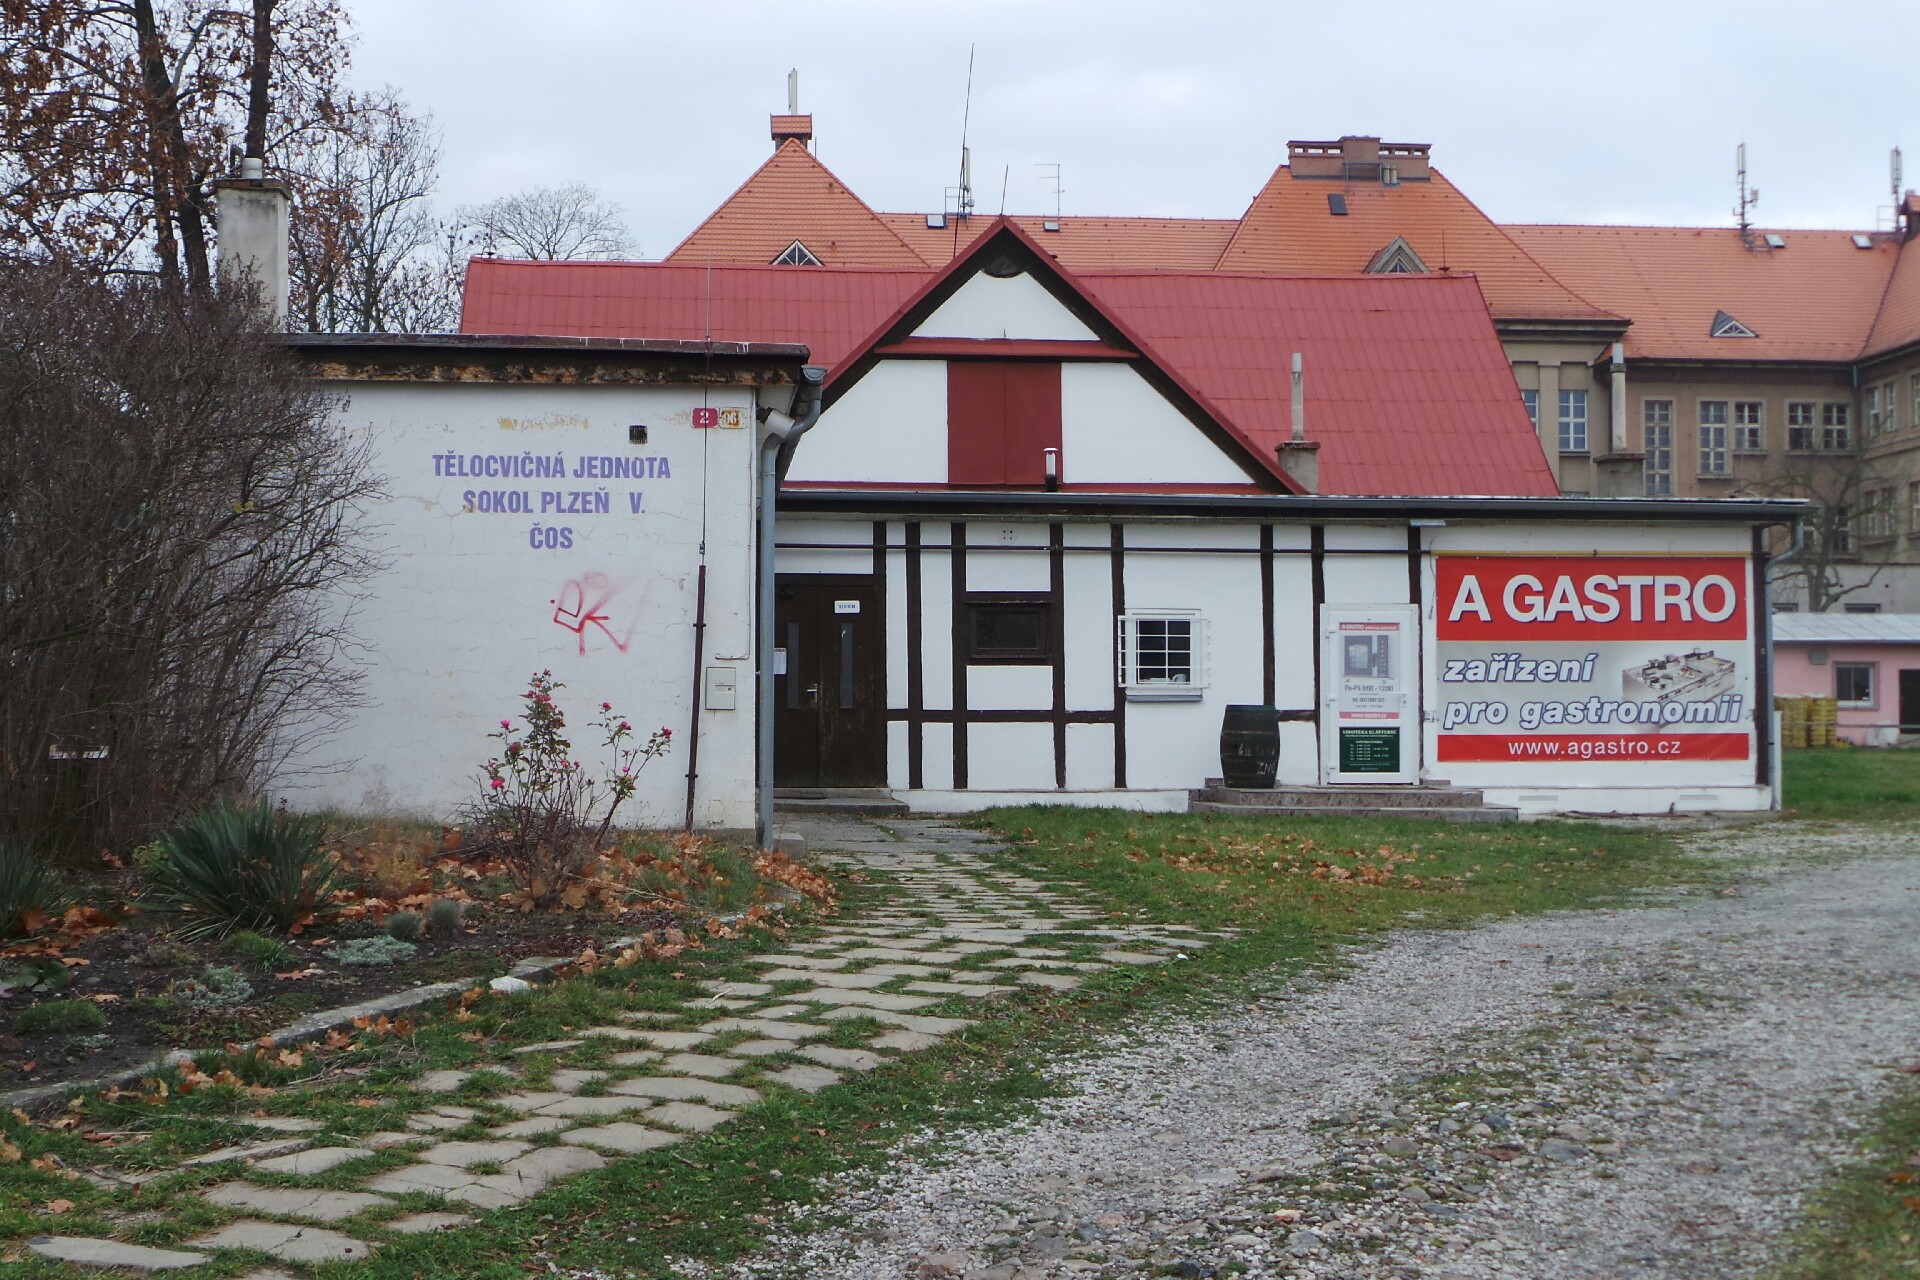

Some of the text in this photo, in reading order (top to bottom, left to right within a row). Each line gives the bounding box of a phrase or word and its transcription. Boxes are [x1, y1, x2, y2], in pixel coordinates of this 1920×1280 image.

[699, 410, 710, 424] 2
[432, 450, 671, 479] TĚLOCVIČNÁ JEDNOTA
[462, 487, 646, 514] SOKOL PLZEŇ V.
[529, 522, 573, 550] ČOS
[1448, 574, 1737, 623] A GASTRO
[1443, 653, 1598, 683] zařízení
[1443, 694, 1743, 730] pro gastronomii
[1508, 739, 1681, 760] www.agastro.cz
